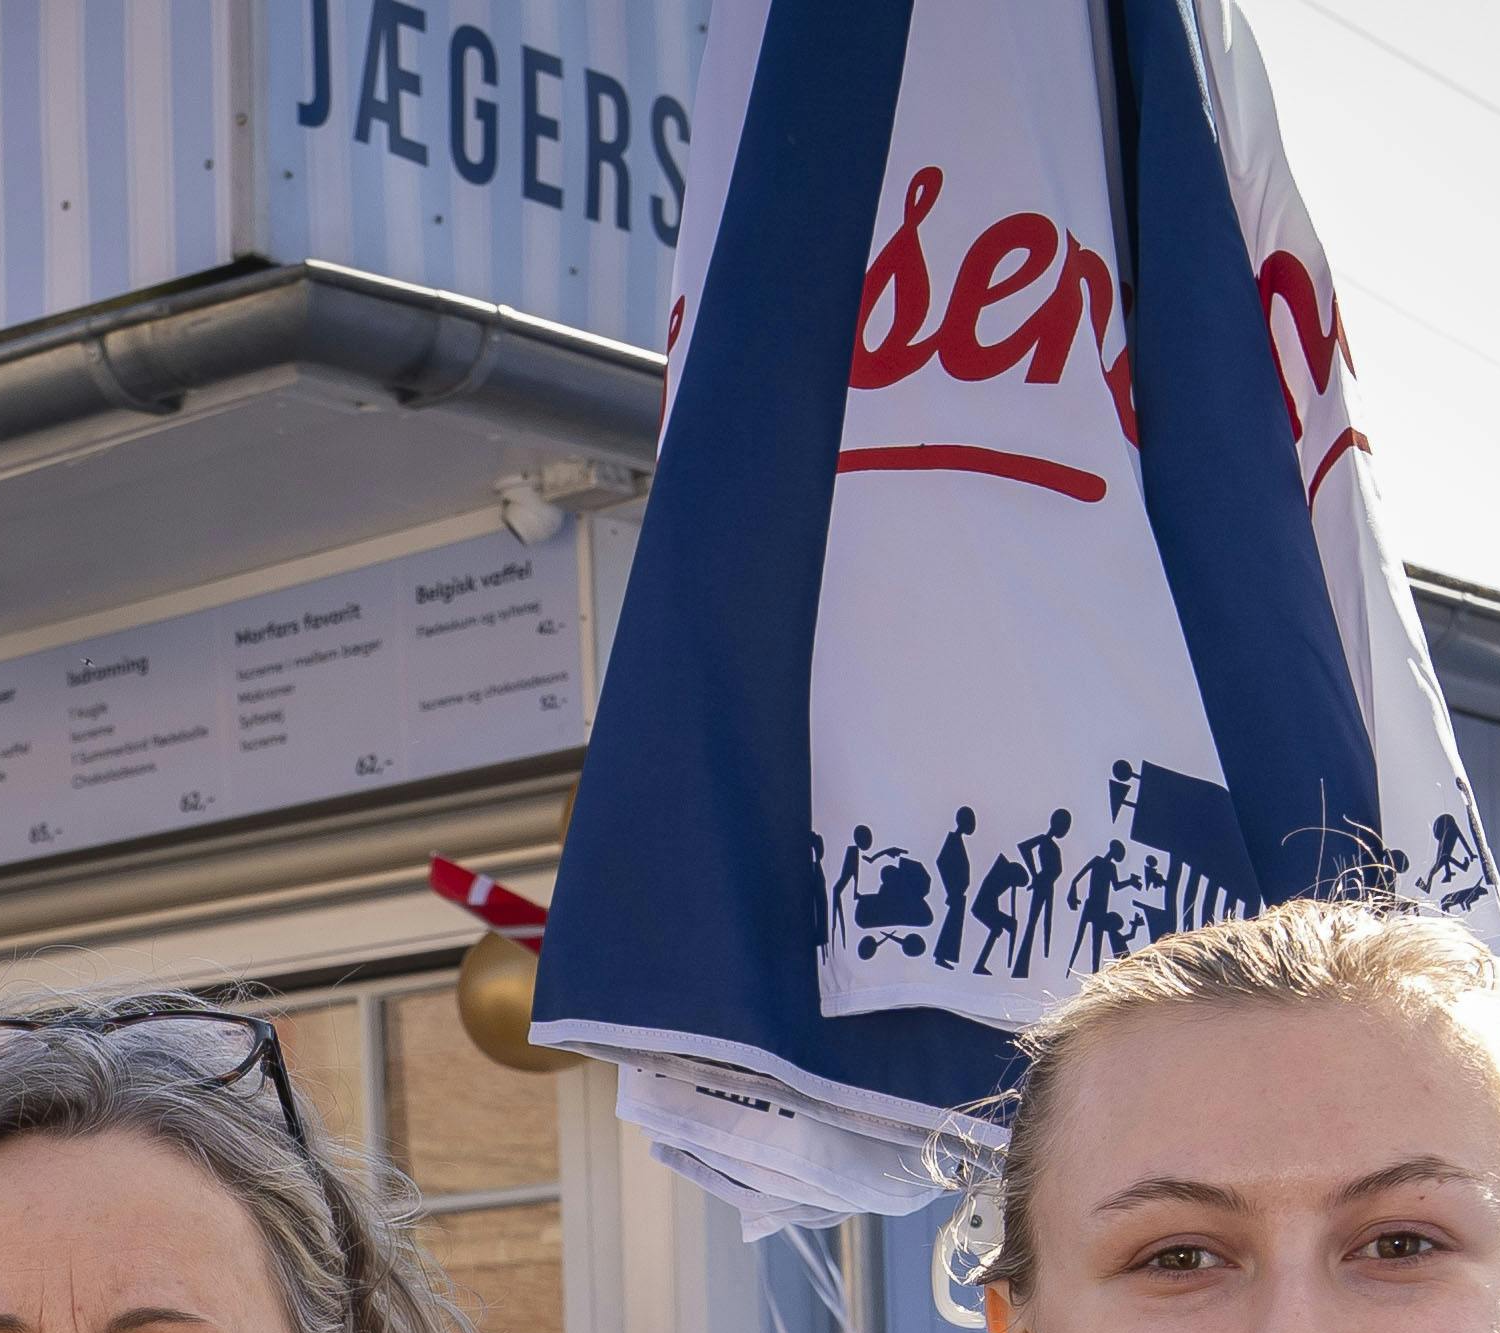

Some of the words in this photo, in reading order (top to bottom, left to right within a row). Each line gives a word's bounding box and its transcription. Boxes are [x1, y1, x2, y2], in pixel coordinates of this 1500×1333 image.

[297, 0, 690, 249] JÆGERS
[415, 574, 475, 604] Belgisk
[481, 560, 532, 588] vaffel
[303, 602, 361, 630] favorit
[355, 752, 394, 777] 62,-
